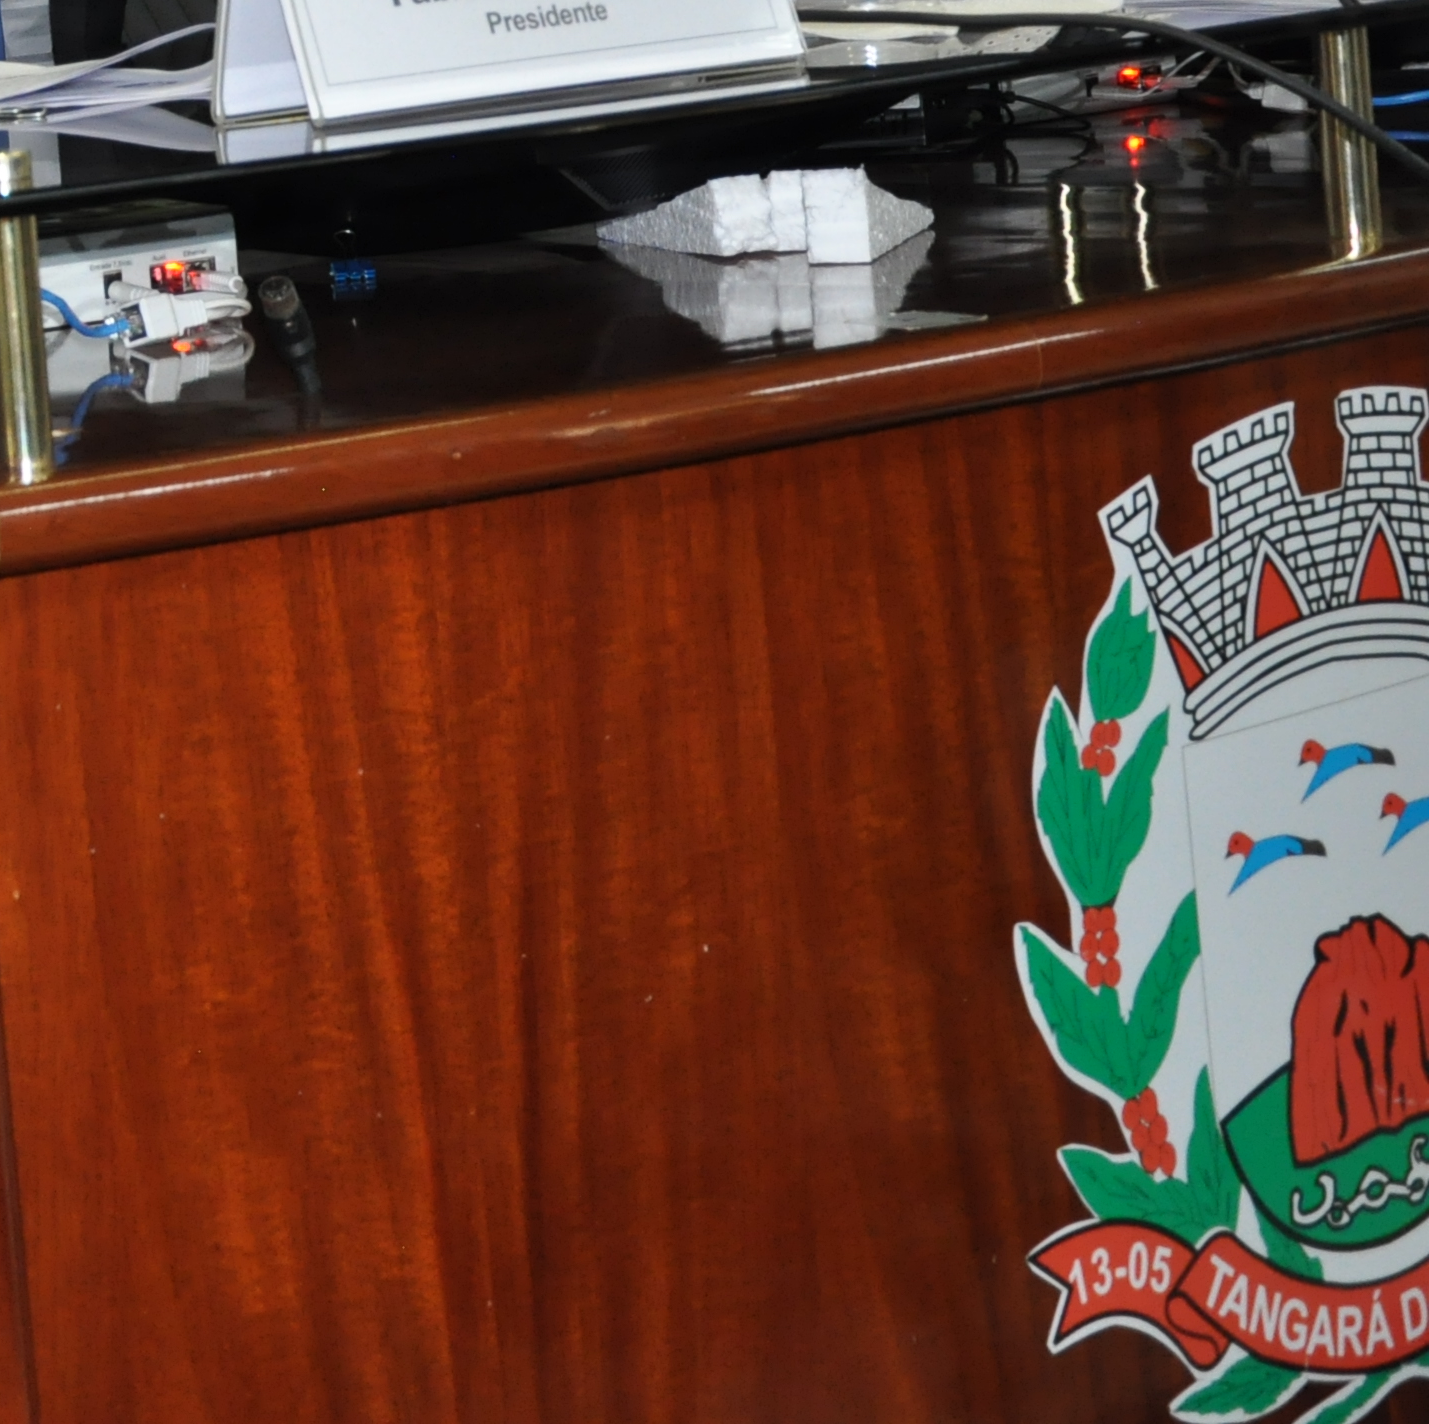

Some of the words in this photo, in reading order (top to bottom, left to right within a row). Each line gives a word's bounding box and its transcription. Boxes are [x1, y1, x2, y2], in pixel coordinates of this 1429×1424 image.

[485, 1, 609, 35] Presidente
[1067, 1240, 1173, 1305] 13-05
[1204, 1254, 1395, 1359] TANGARÁ
[1400, 1286, 1429, 1341] D
